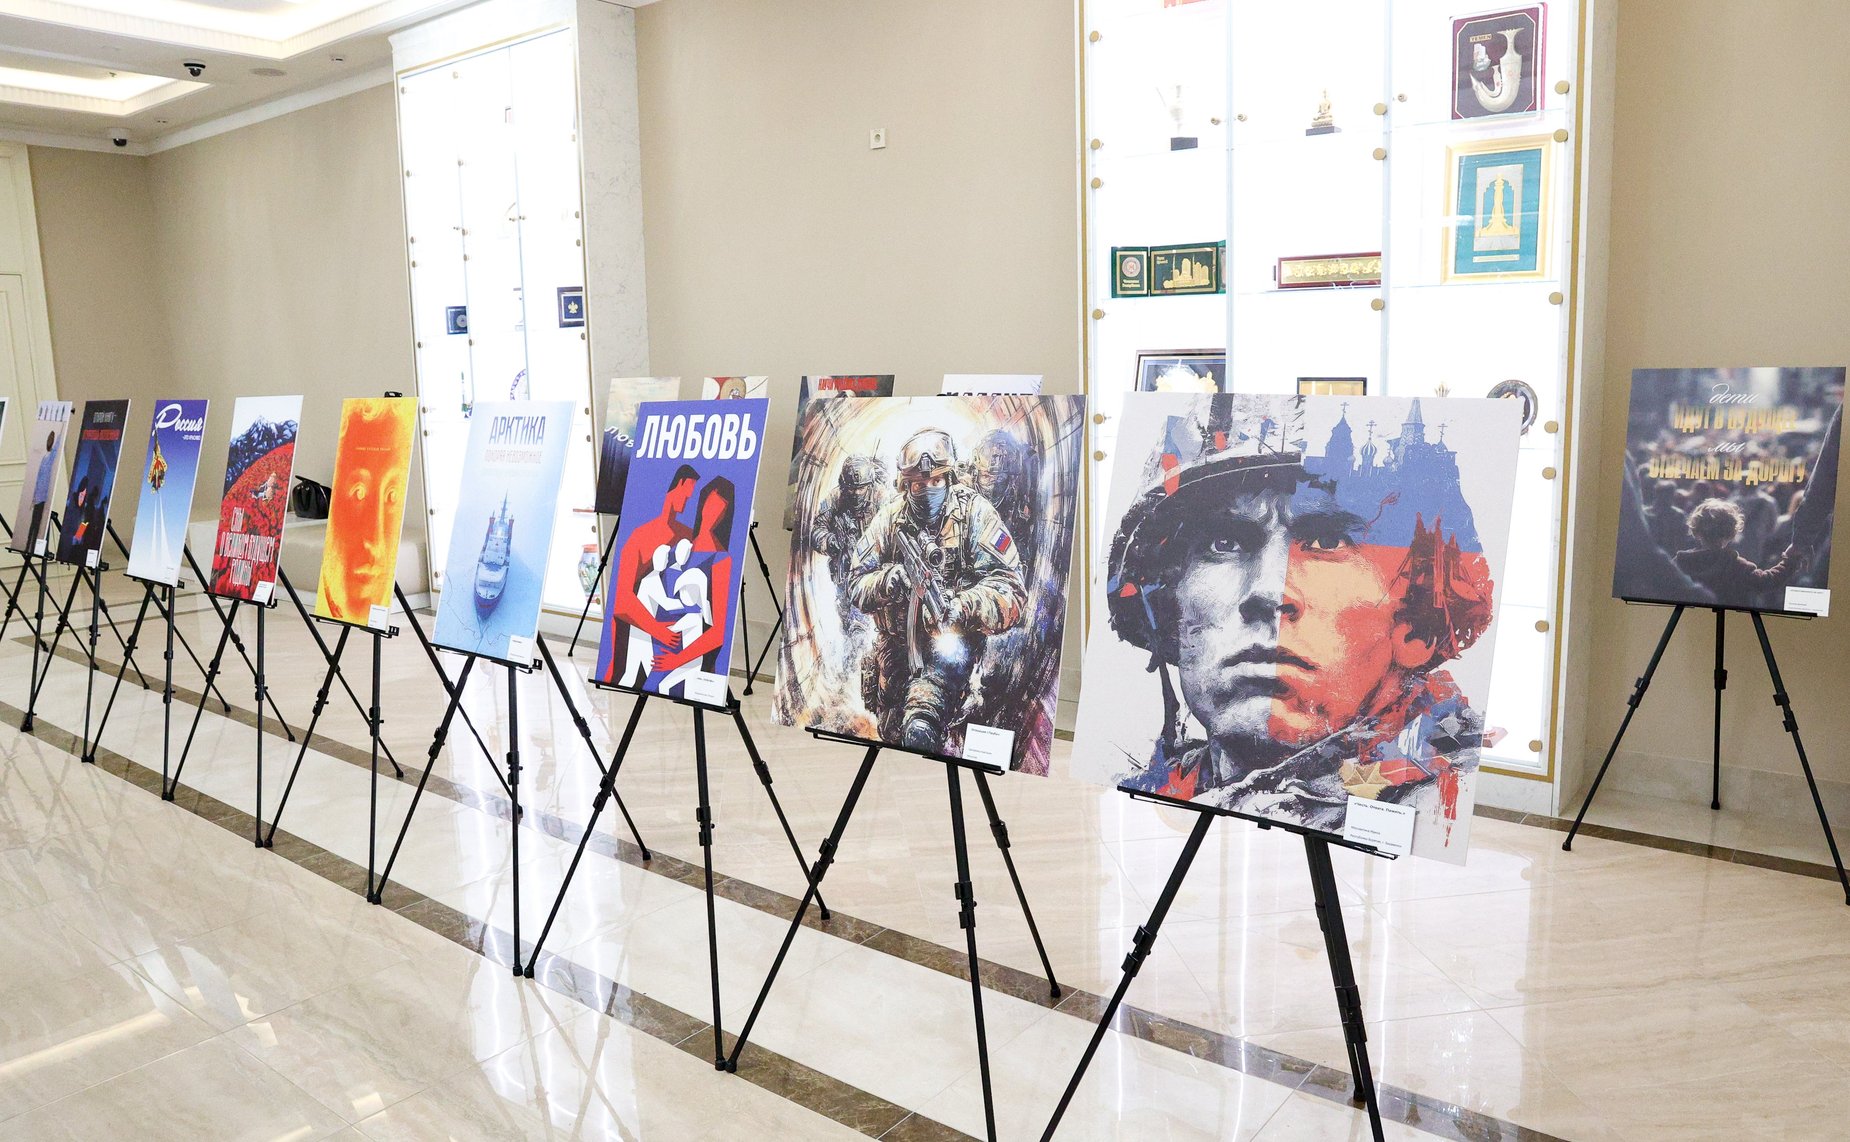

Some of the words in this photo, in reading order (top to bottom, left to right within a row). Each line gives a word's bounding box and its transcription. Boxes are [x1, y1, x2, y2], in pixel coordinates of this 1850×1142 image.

[1709, 383, 1760, 404] дети
[489, 416, 546, 445] АРКТИКА
[636, 413, 757, 460] ЛЮБОВЬ
[1649, 453, 1720, 481] ОТВЕЧАЕМ
[1723, 456, 1743, 482] ЗА
[1745, 457, 1806, 486] ДОРОГУ
